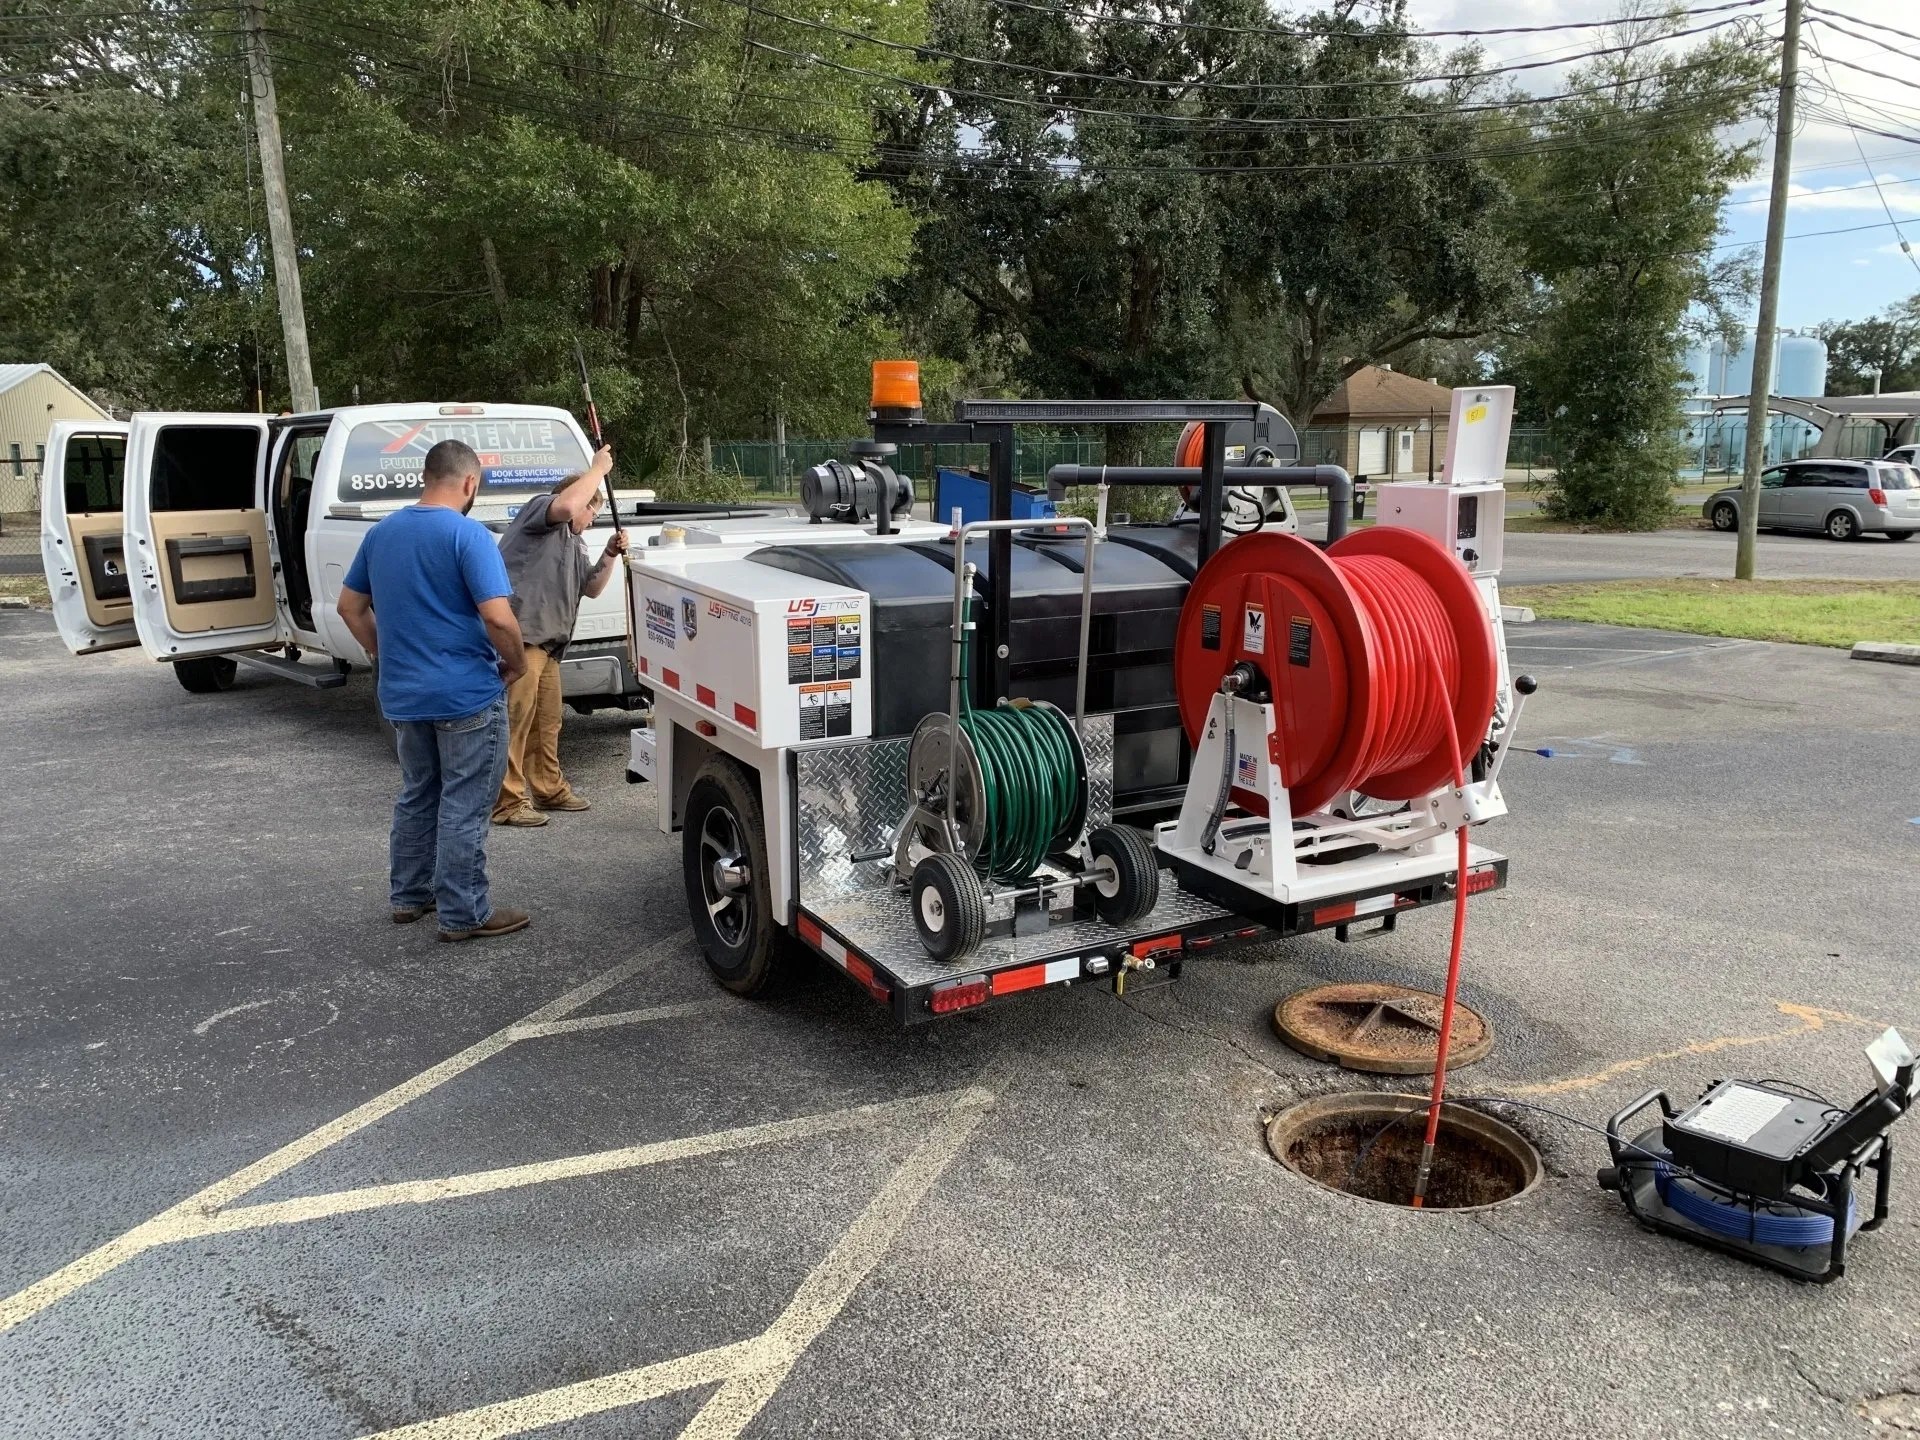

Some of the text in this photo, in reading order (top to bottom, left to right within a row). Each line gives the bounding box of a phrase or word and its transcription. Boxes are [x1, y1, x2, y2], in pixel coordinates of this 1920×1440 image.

[371, 421, 555, 453] XTREME
[380, 457, 427, 470] PUMP
[503, 454, 557, 466] SEPTIC
[488, 475, 563, 484] www.XtremePumpingandSe
[491, 470, 514, 478] BOOK
[514, 468, 548, 477] SERVICES
[351, 472, 426, 491] 850-999
[645, 597, 676, 622] XTREME
[1239, 752, 1252, 762] MADE
